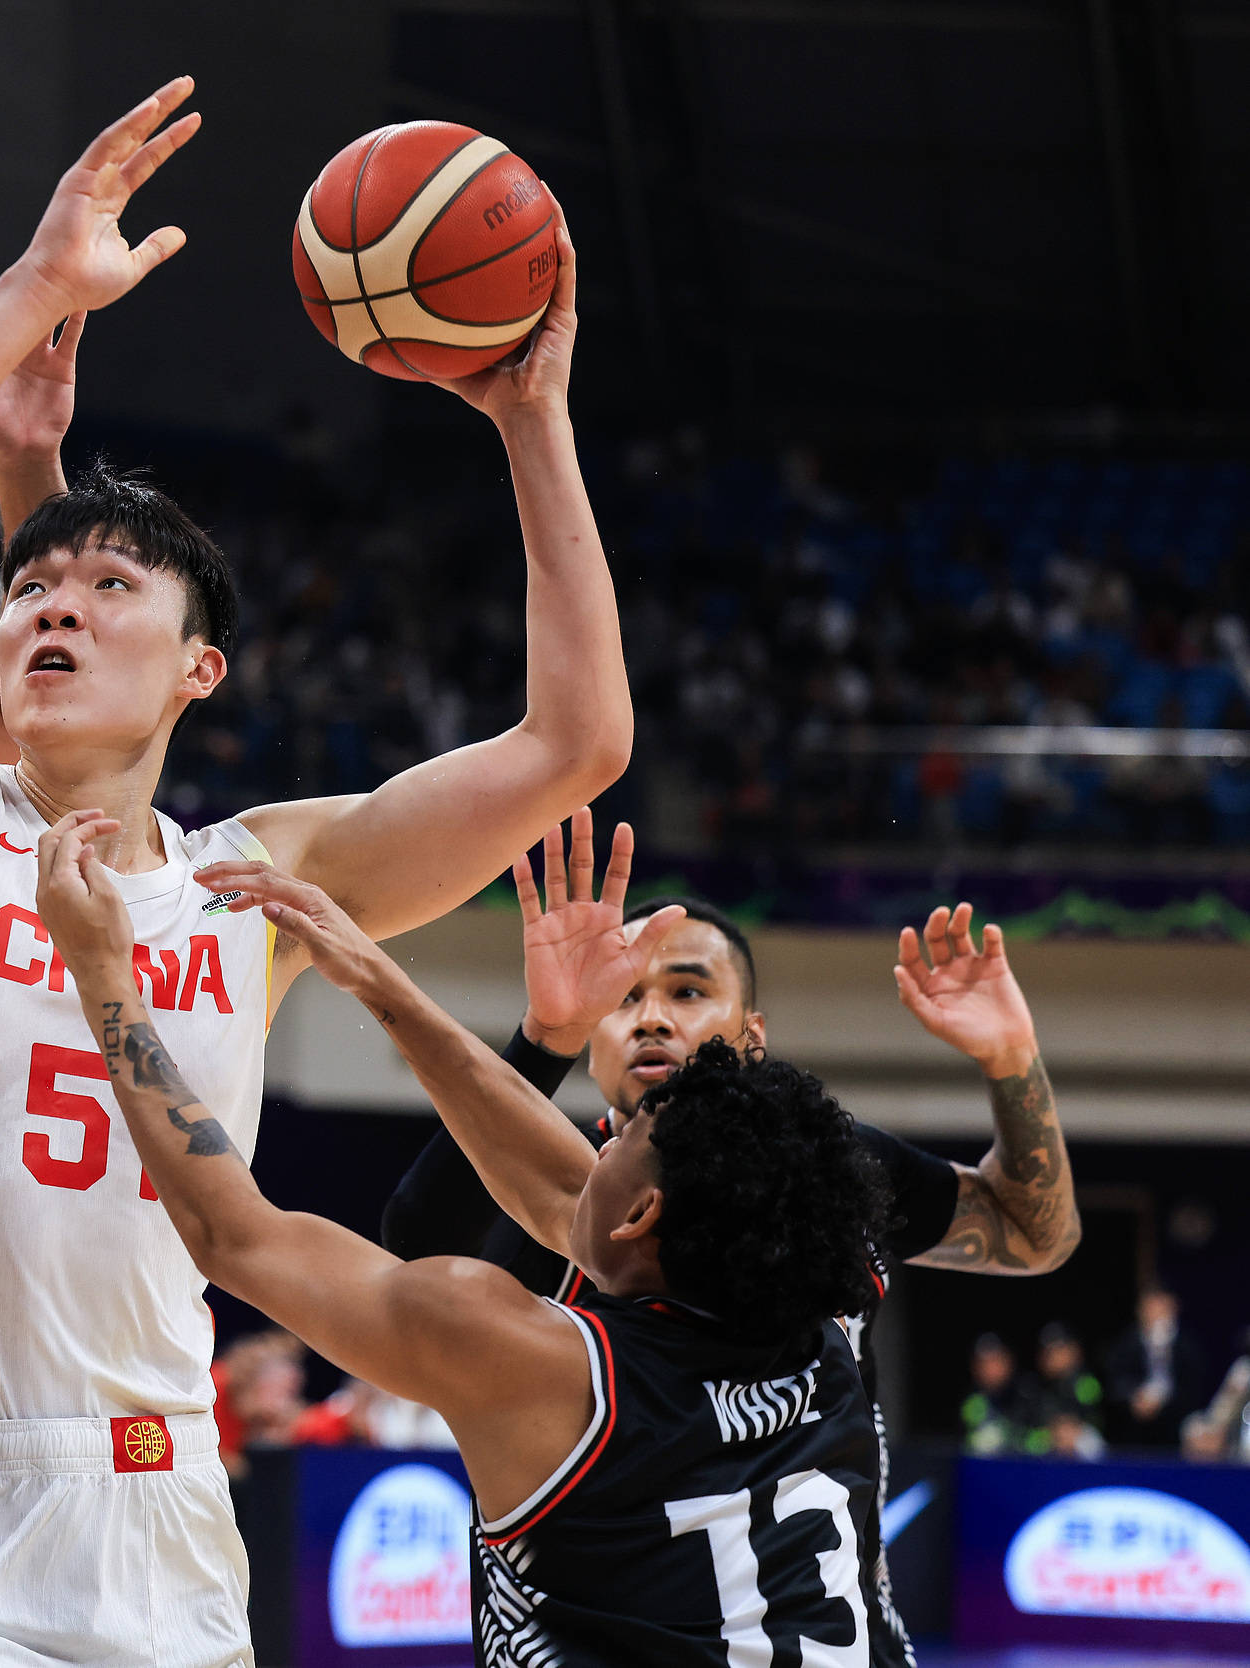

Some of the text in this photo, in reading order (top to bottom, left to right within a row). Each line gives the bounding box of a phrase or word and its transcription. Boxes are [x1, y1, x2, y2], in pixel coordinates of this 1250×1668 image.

[22, 1042, 160, 1201] 5
[141, 1421, 152, 1464] CHN
[703, 1358, 823, 1443] WHITE
[664, 1467, 870, 1668] 13
